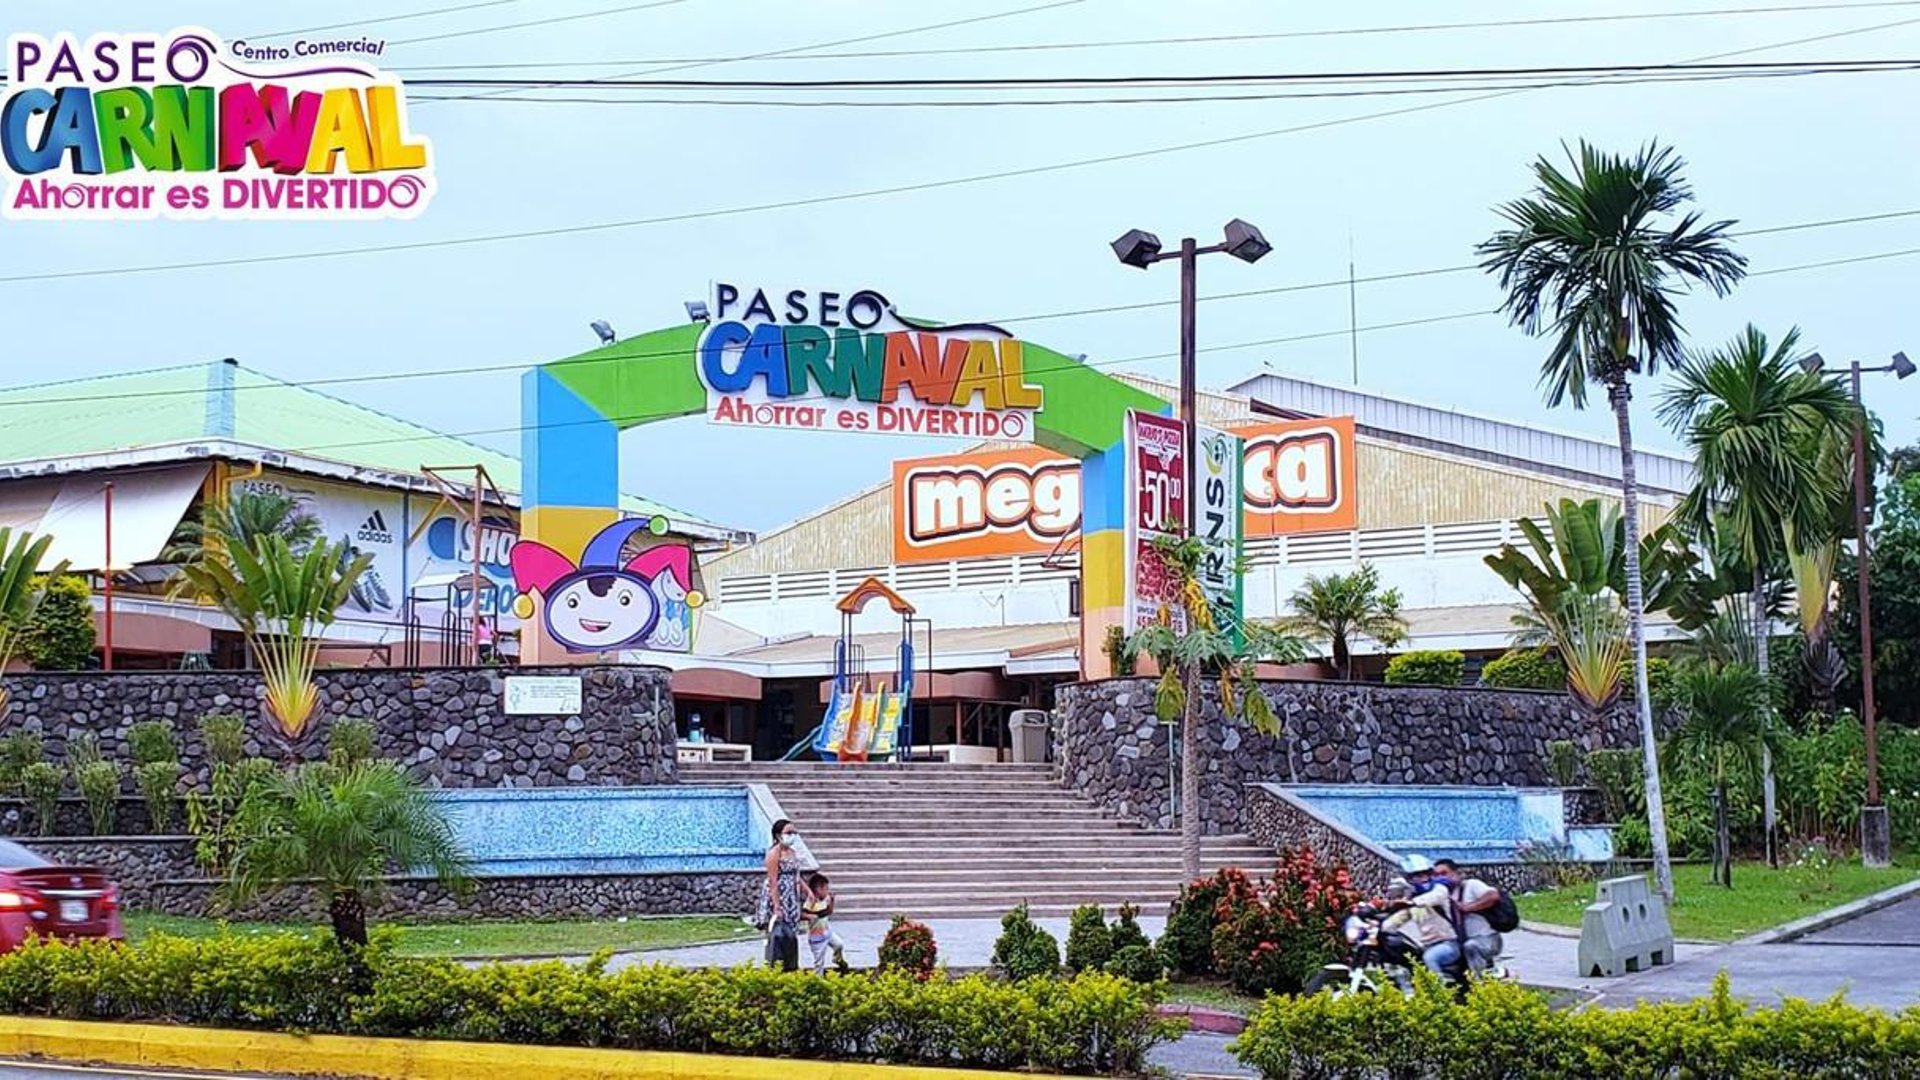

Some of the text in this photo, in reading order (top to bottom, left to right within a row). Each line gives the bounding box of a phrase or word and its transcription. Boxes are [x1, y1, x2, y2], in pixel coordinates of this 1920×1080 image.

[716, 283, 891, 330] PASEO
[702, 321, 1043, 411] CARNAVAL
[714, 397, 1027, 439] Ahorrar es DIVERTIDO
[357, 528, 393, 544] adidas
[459, 518, 515, 567] SHO
